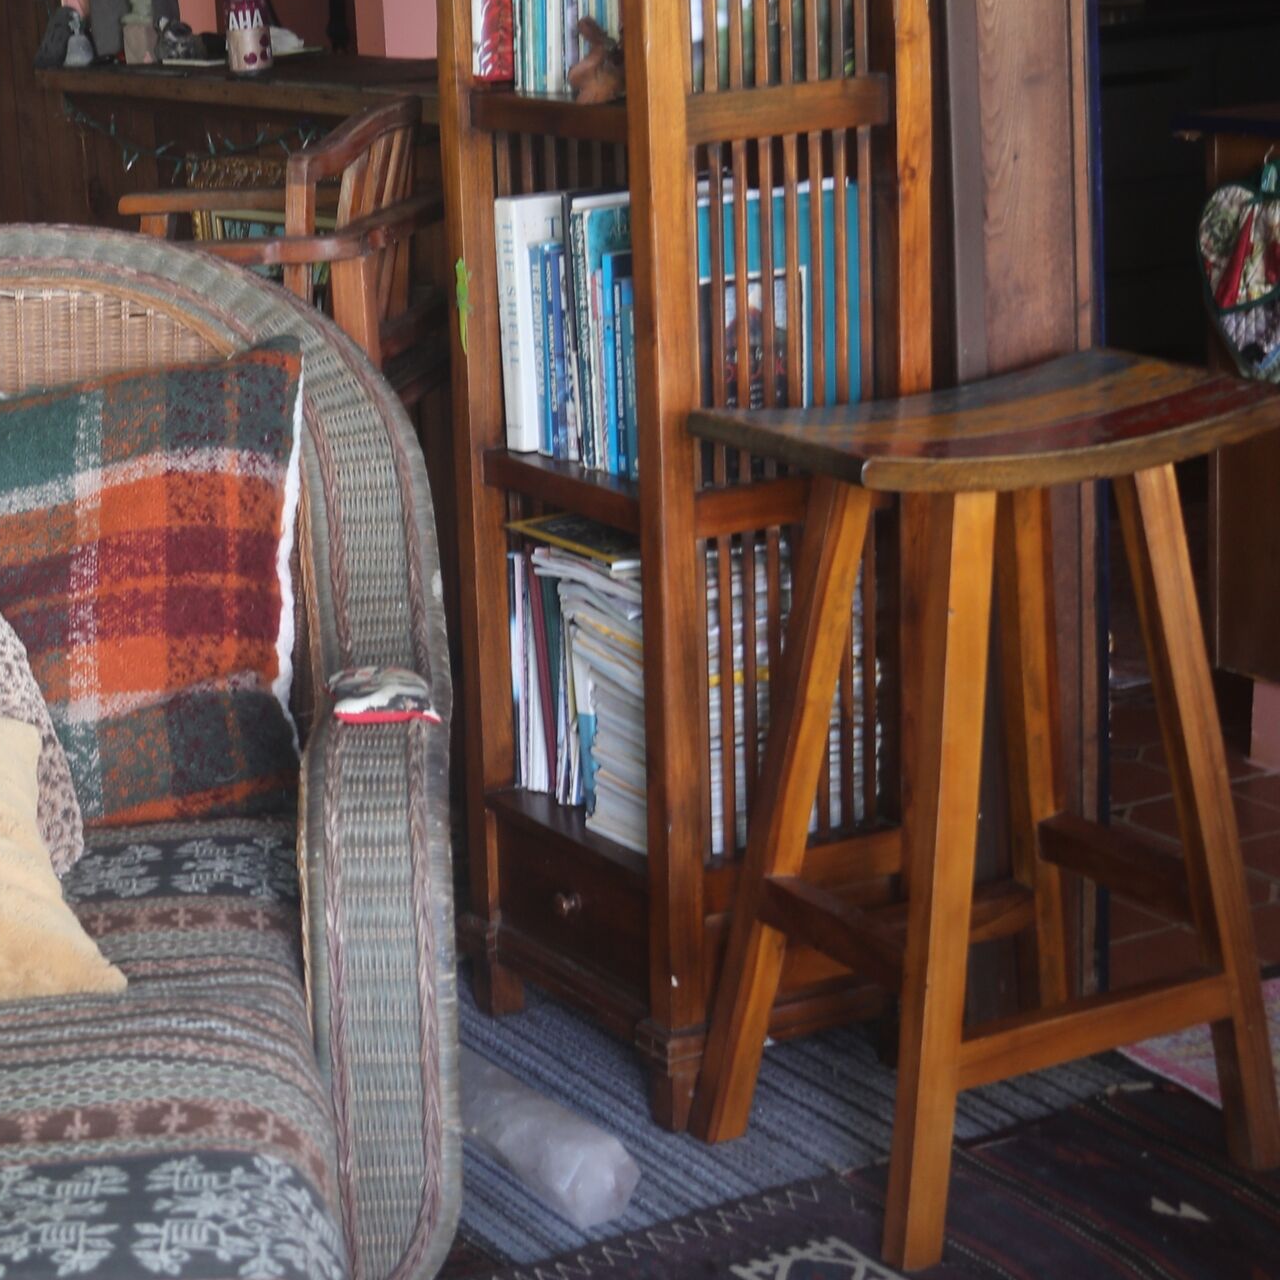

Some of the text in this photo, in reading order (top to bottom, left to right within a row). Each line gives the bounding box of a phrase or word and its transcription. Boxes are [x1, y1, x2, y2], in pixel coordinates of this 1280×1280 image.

[228, 9, 264, 32] AHA
[502, 220, 520, 367] THE SHELL
